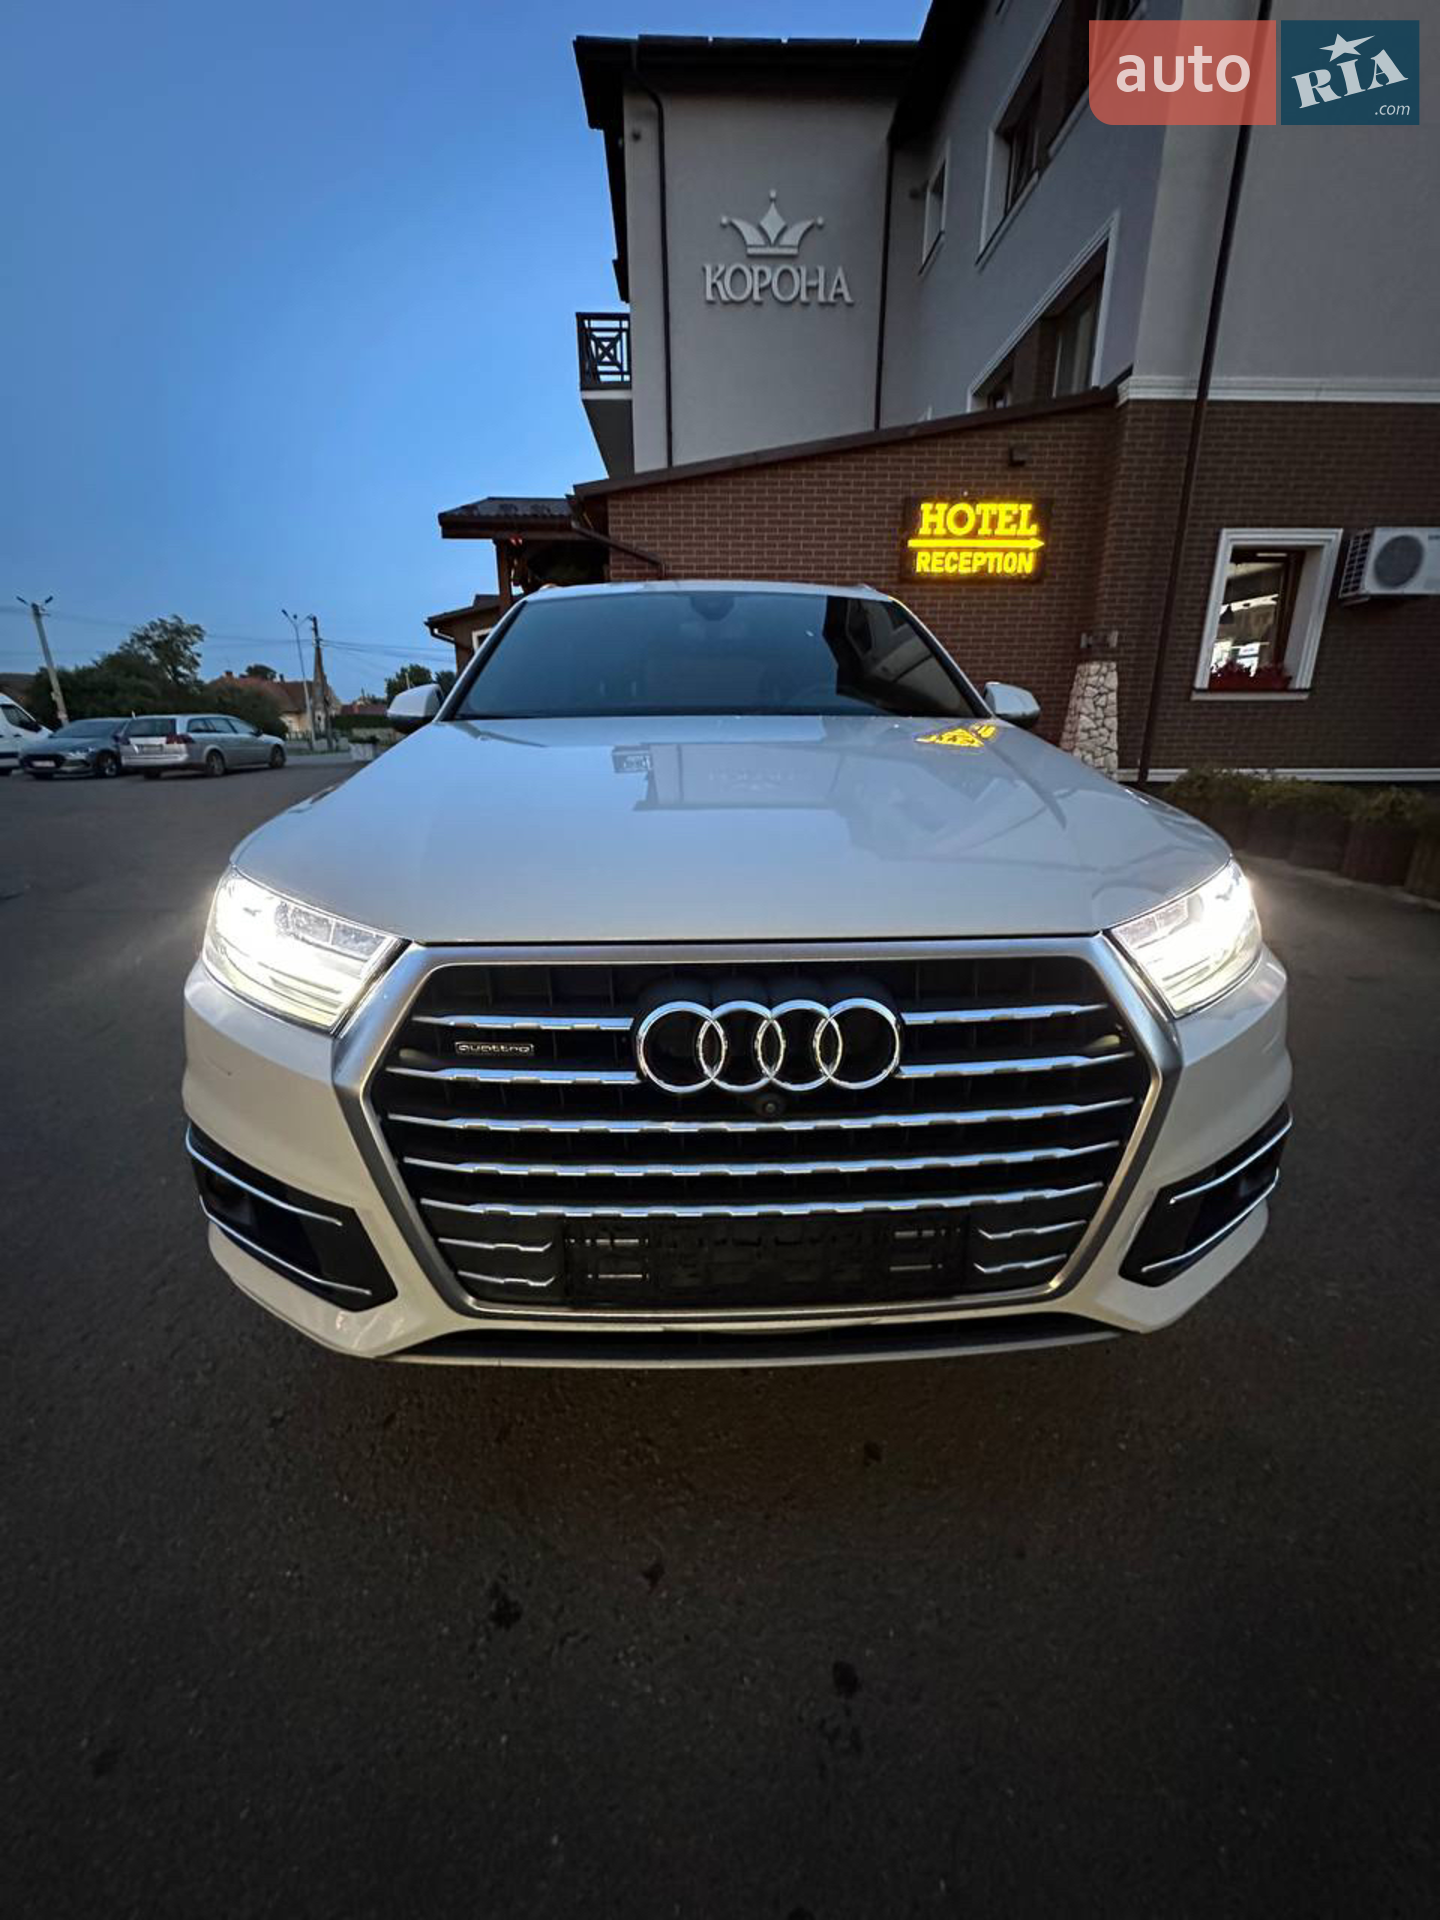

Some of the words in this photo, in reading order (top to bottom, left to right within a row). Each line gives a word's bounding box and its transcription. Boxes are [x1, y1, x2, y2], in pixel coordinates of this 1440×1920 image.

[703, 263, 855, 304] КОРОНА
[918, 502, 1038, 536] HOTEL
[915, 551, 1035, 574] RECEPTION
[458, 1044, 531, 1054] quattro
